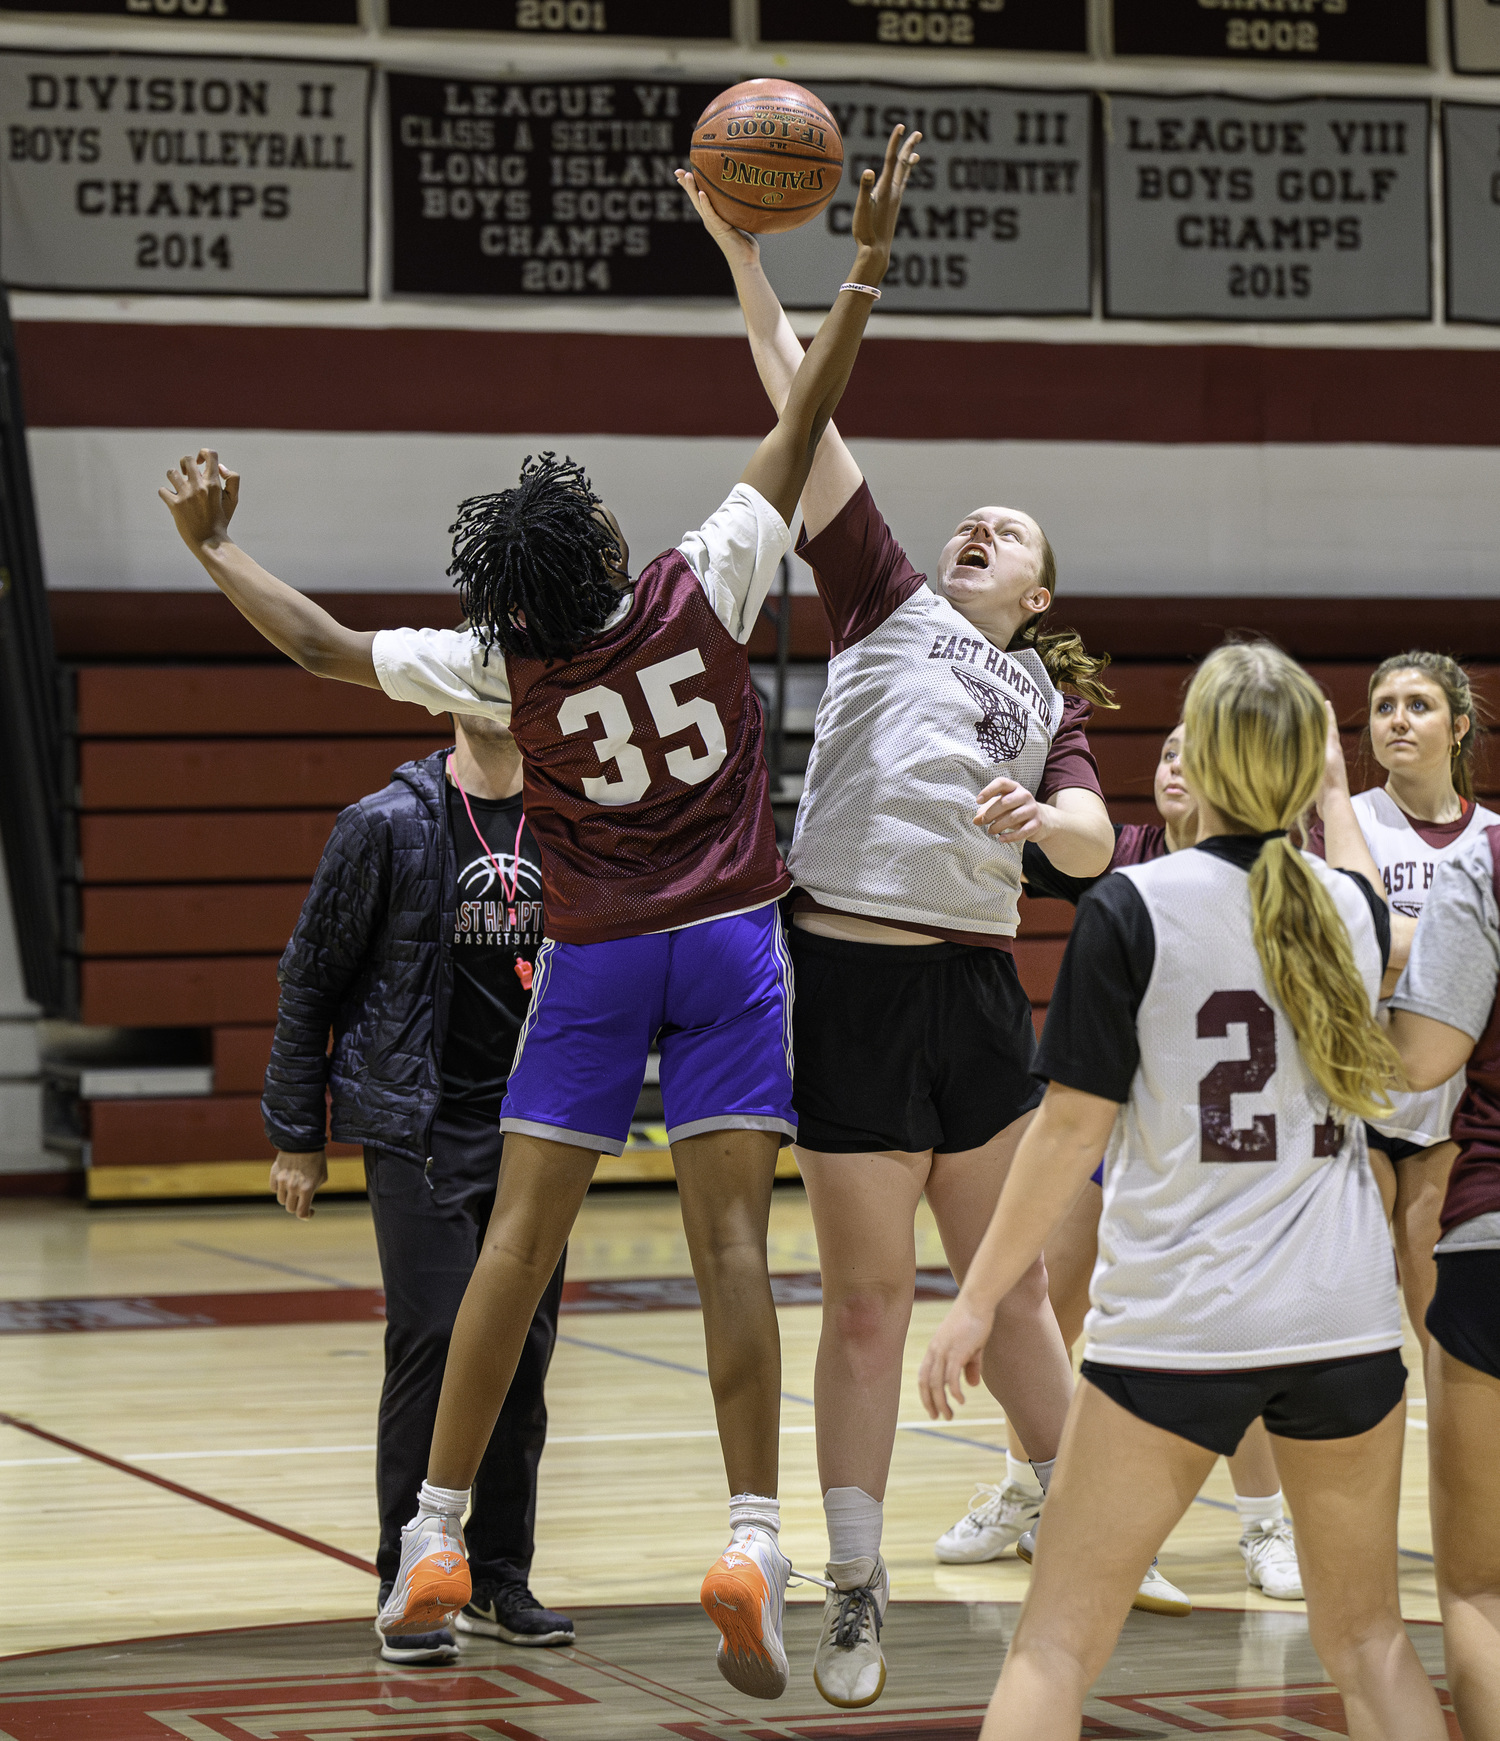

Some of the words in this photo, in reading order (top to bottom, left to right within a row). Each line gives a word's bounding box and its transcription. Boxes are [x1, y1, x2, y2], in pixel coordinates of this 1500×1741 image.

[516, 0, 606, 31] 2001
[877, 11, 975, 44] 2002
[1226, 18, 1319, 52] 2002
[28, 73, 268, 116] DIVISION
[297, 83, 335, 118] II
[444, 85, 615, 117] LEAGUE
[634, 86, 680, 117] VI
[400, 115, 496, 149] CLASS
[514, 120, 533, 150] A
[551, 119, 674, 150] SECTION
[727, 120, 826, 149] TF-1000
[830, 103, 990, 144] VISION
[1016, 110, 1068, 146] III
[1126, 117, 1306, 154] LEAGUE
[1330, 120, 1408, 155] VIII
[8, 124, 101, 163] BOYS
[126, 128, 354, 170] VOLLEYBALL
[420, 152, 527, 185] LONG
[549, 154, 692, 187] ISLAN
[721, 156, 826, 191] SPALDING
[948, 157, 1080, 193] COUNTRY
[1136, 166, 1254, 200] BOYS
[1276, 168, 1397, 203] GOLF
[76, 180, 291, 220] CHAMPS
[421, 188, 531, 220] BOYS
[826, 202, 1019, 241] CAMPS
[1176, 215, 1362, 251] CHAMPS
[136, 233, 232, 270] 2014
[480, 225, 649, 257] CHAMPS
[522, 260, 610, 292] 2014
[881, 253, 969, 287] 2015
[1228, 263, 1312, 298] 2015
[928, 635, 984, 664] EAST
[984, 648, 1052, 728] HAMPTON
[557, 648, 727, 807] 35
[1379, 861, 1417, 895] AST
